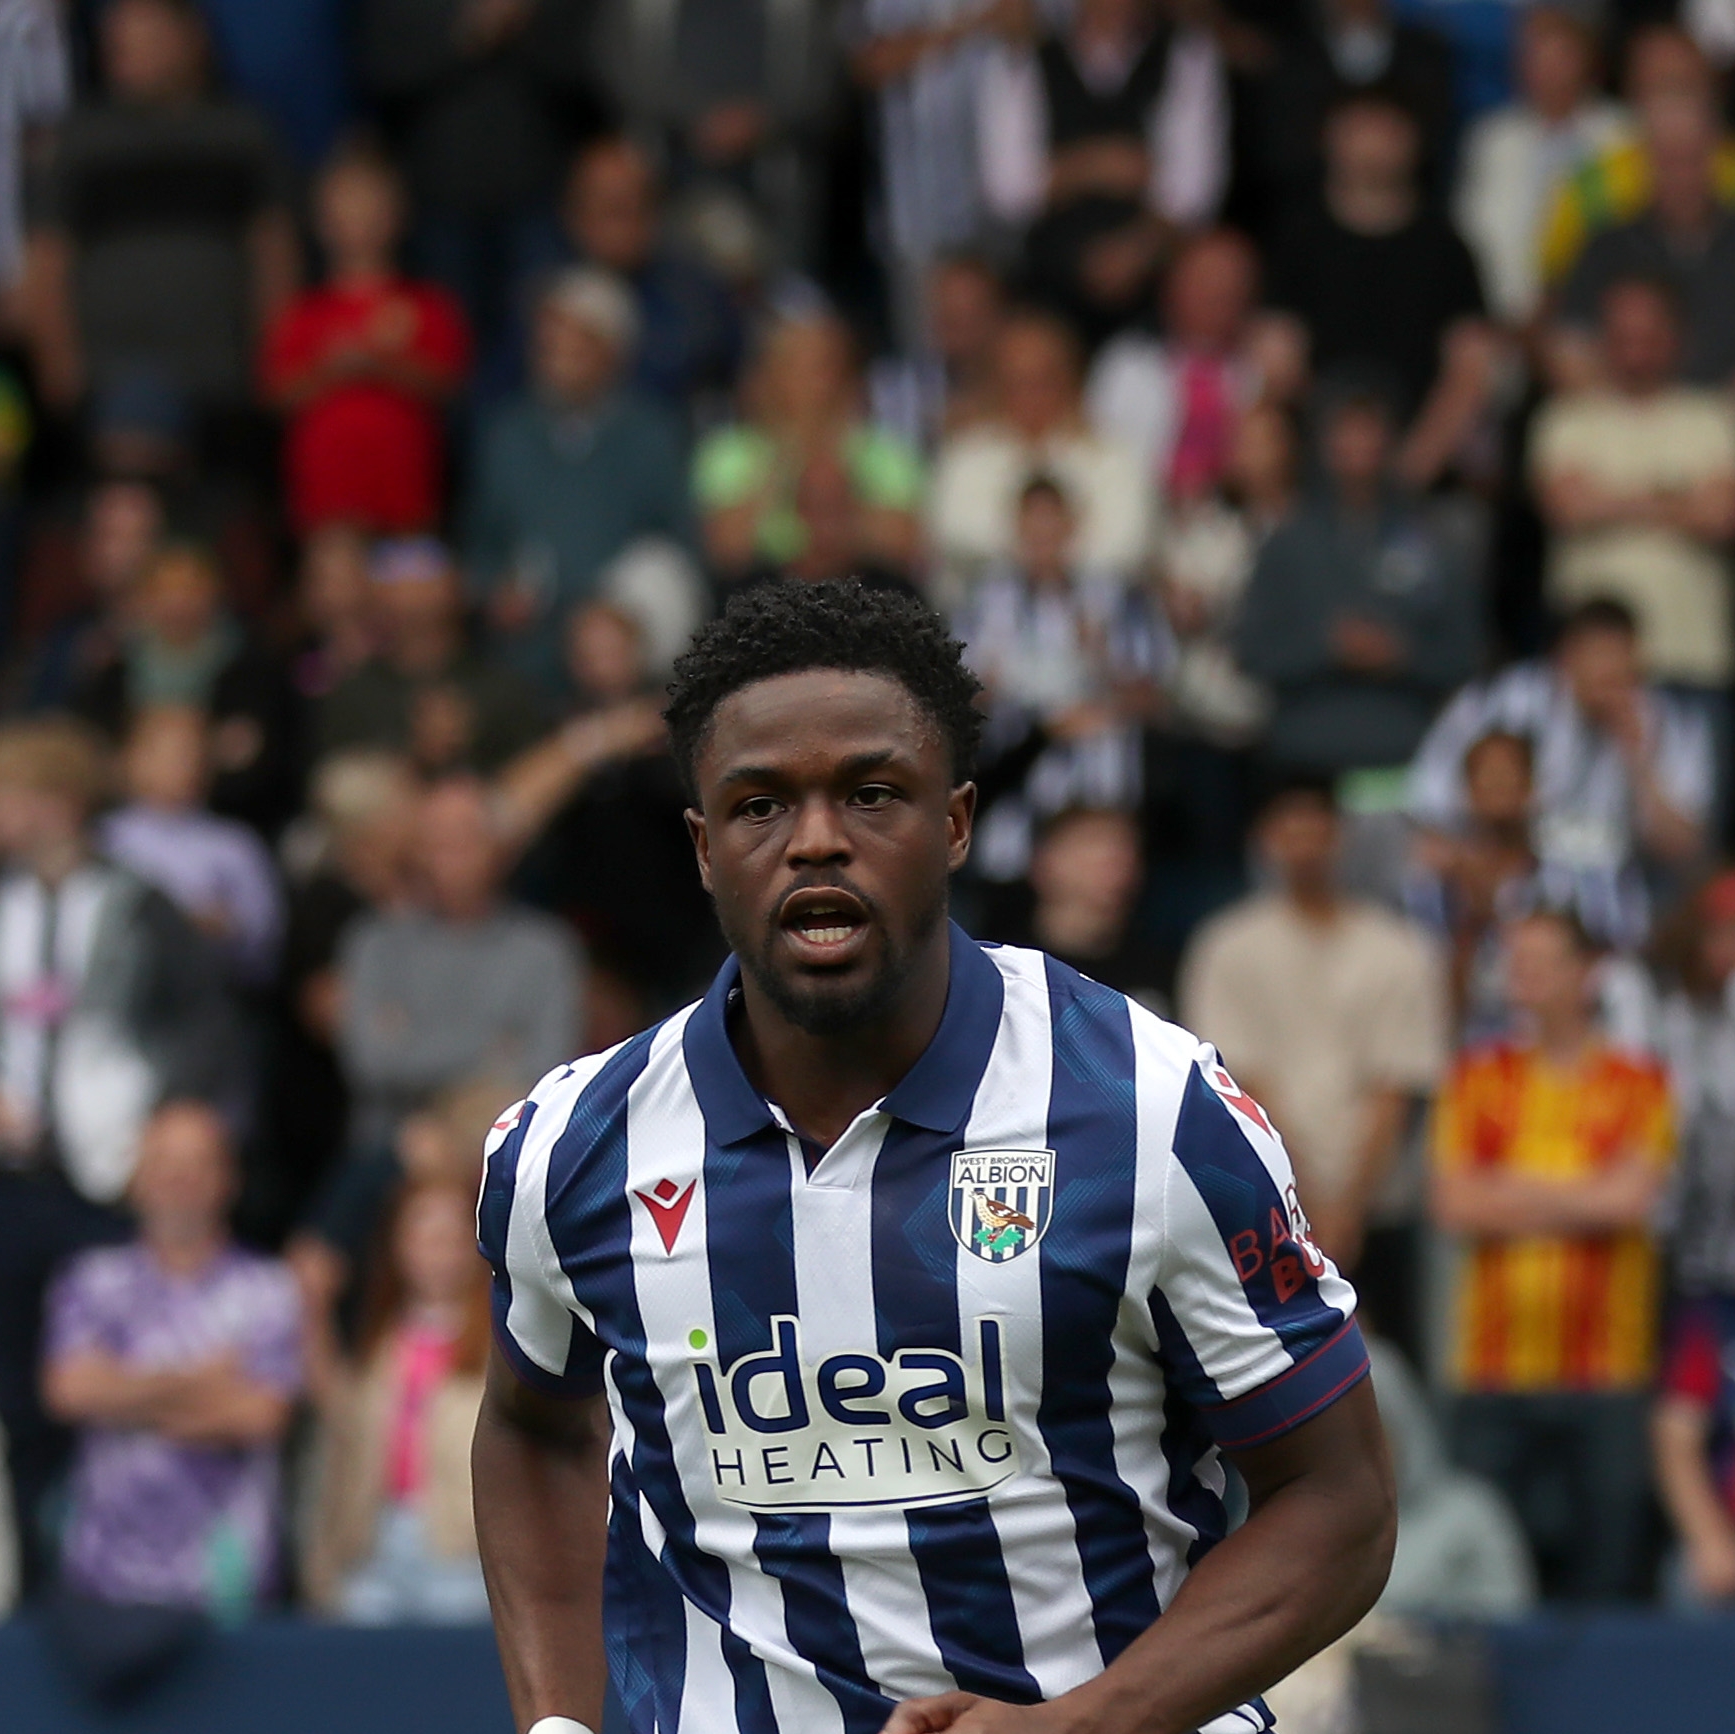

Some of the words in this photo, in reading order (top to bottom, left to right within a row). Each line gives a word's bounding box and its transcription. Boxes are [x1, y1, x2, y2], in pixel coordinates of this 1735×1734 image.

[957, 1165, 1046, 1184] ALBION
[958, 1156, 988, 1166] WEST
[989, 1156, 1047, 1165] BROMWICH
[688, 1319, 1007, 1435] ideal
[711, 1428, 1014, 1486] HEATING
